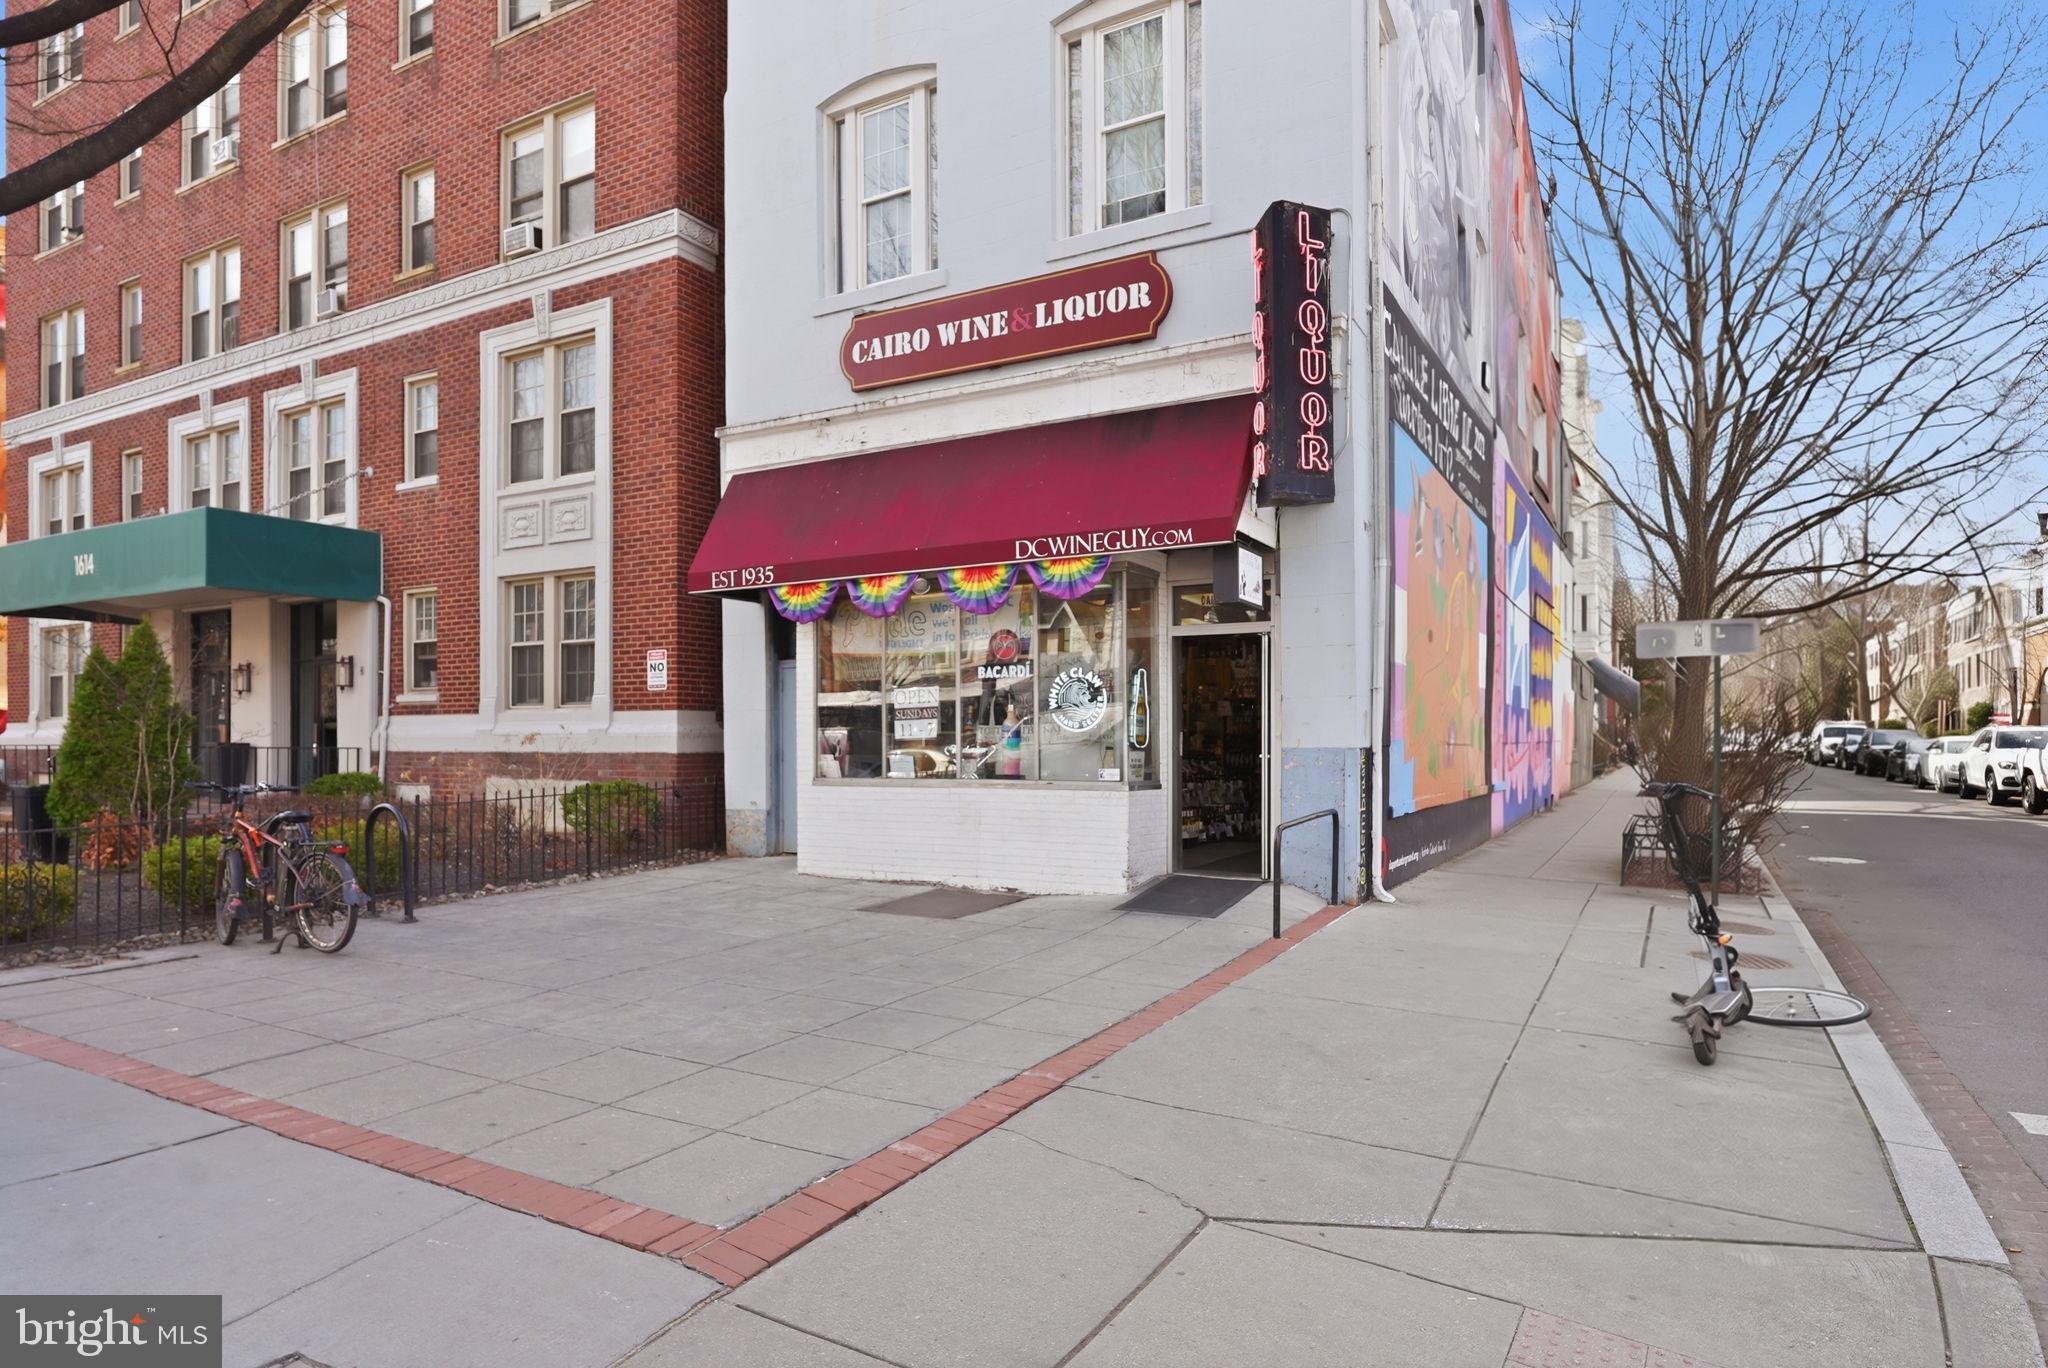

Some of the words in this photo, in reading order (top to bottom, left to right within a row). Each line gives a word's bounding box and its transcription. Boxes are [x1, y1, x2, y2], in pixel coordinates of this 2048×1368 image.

[851, 328, 931, 365] CAIRO
[936, 310, 1010, 348] WINE
[1011, 307, 1034, 333] &
[1034, 281, 1152, 329] LIQUOR
[1298, 211, 1330, 472] LIQUOR
[1015, 527, 1193, 560] DCWINEGUY.COM
[74, 552, 95, 577] 1614
[711, 569, 738, 589] EST
[741, 565, 774, 586] 1935
[649, 662, 665, 672] NO
[977, 661, 1031, 679] BACARDÍ
[895, 687, 938, 706] OPEN
[1048, 671, 1070, 710] WHITE
[1069, 667, 1104, 688] CLAW
[895, 708, 939, 720] SUNDAYS
[1058, 714, 1080, 729] HARD
